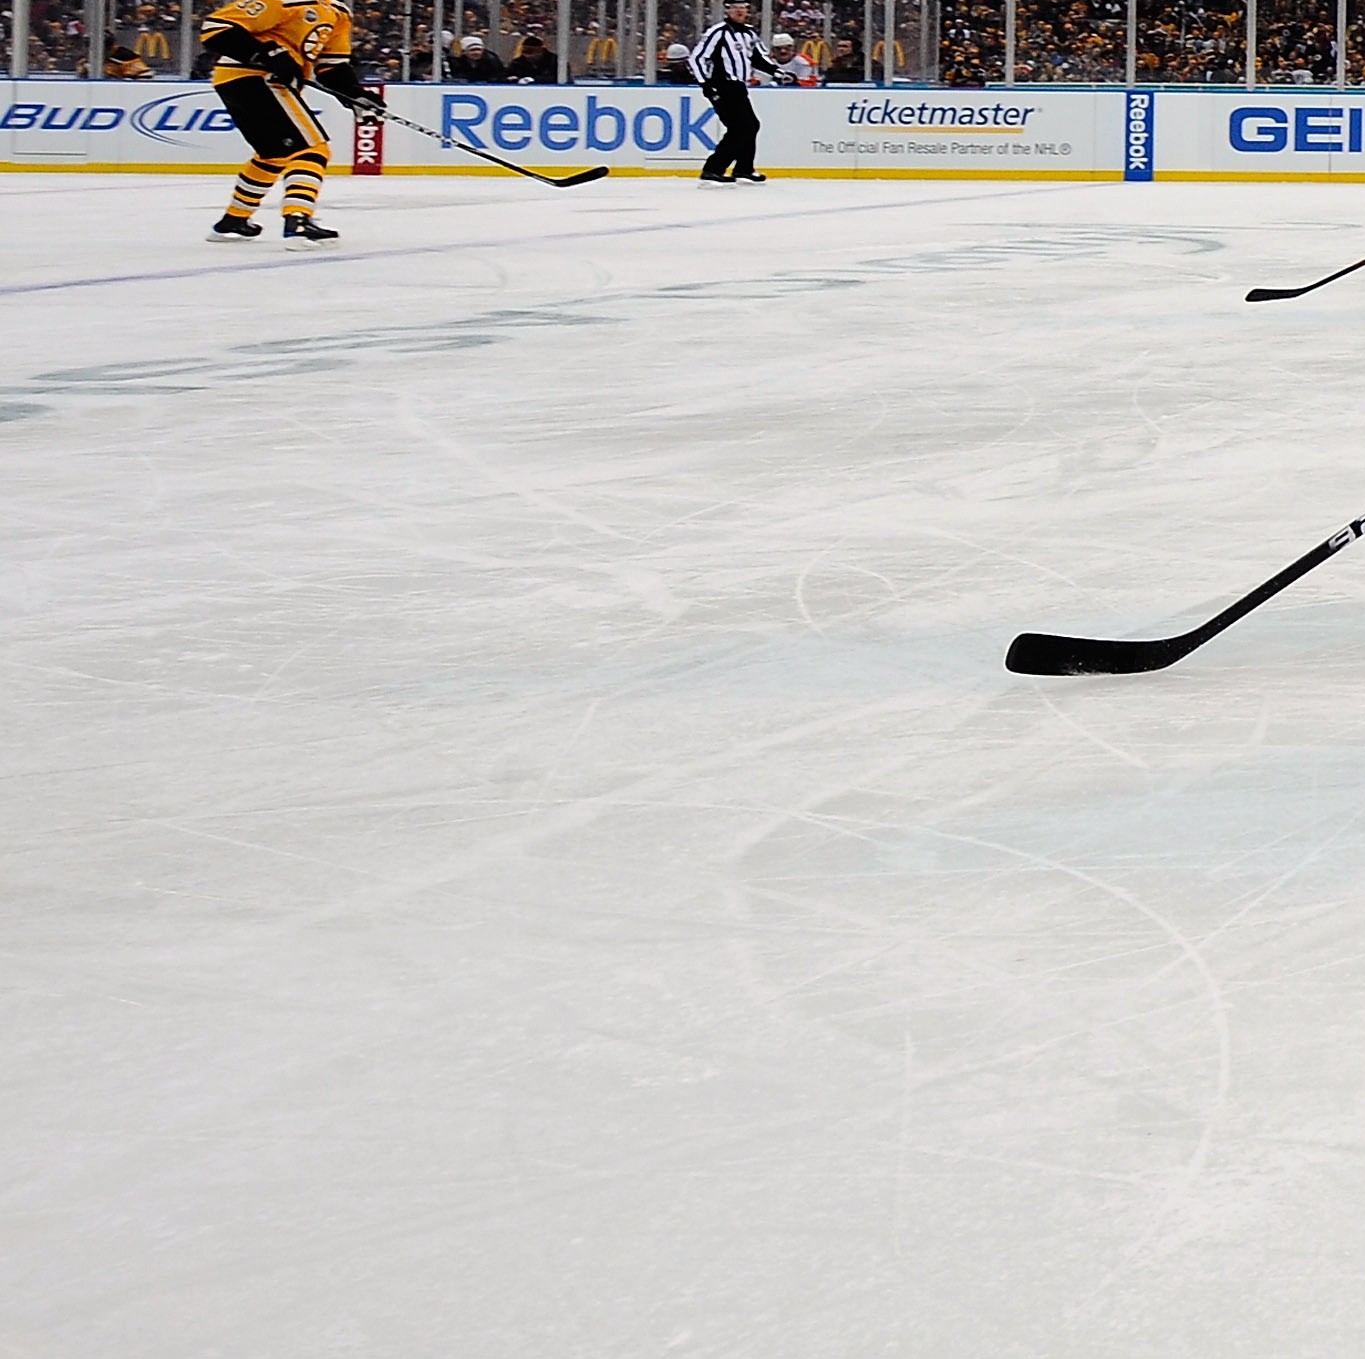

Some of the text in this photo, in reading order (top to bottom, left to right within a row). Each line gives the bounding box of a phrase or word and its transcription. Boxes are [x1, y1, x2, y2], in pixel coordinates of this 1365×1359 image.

[0, 103, 125, 131] BUD
[441, 93, 718, 152] Reebok
[847, 98, 1035, 127] ticketmaster
[1128, 93, 1150, 171] Reebok
[812, 141, 835, 154] The
[838, 141, 879, 156] Official
[882, 142, 905, 155] Fan
[908, 142, 948, 155] Resale
[951, 142, 993, 156] Partner
[997, 142, 1011, 155] of
[1013, 142, 1032, 156] the
